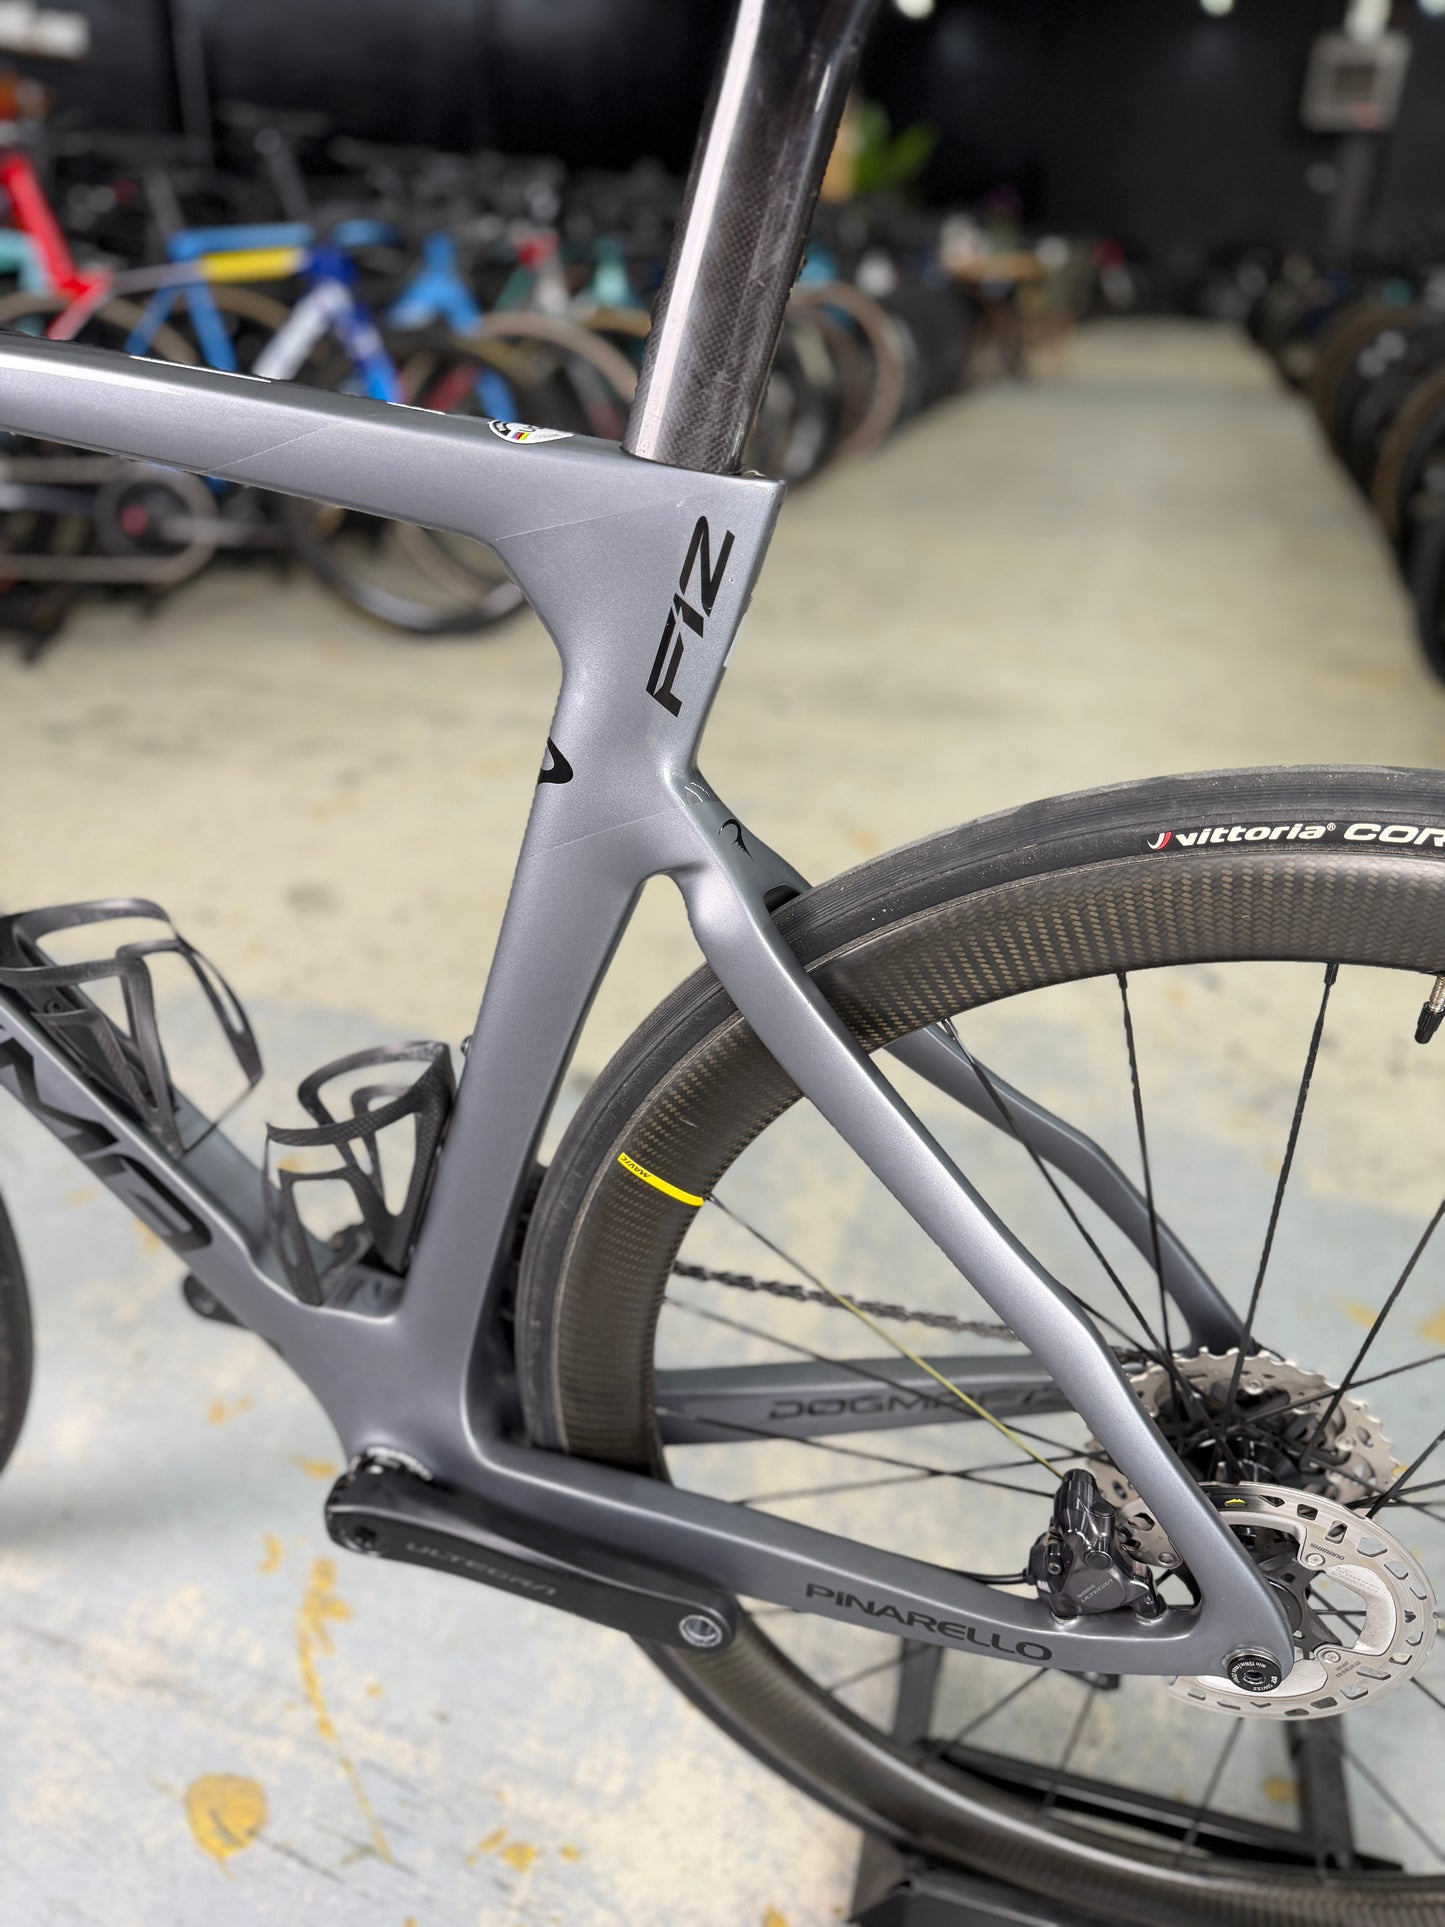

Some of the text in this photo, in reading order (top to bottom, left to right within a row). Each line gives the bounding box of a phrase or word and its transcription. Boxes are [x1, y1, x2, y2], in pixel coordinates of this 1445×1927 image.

[645, 515, 736, 718] F12
[620, 1156, 651, 1178] MAVIC
[1309, 1542, 1345, 1561] SHIMANO
[805, 1583, 1053, 1661] PINARELLO
